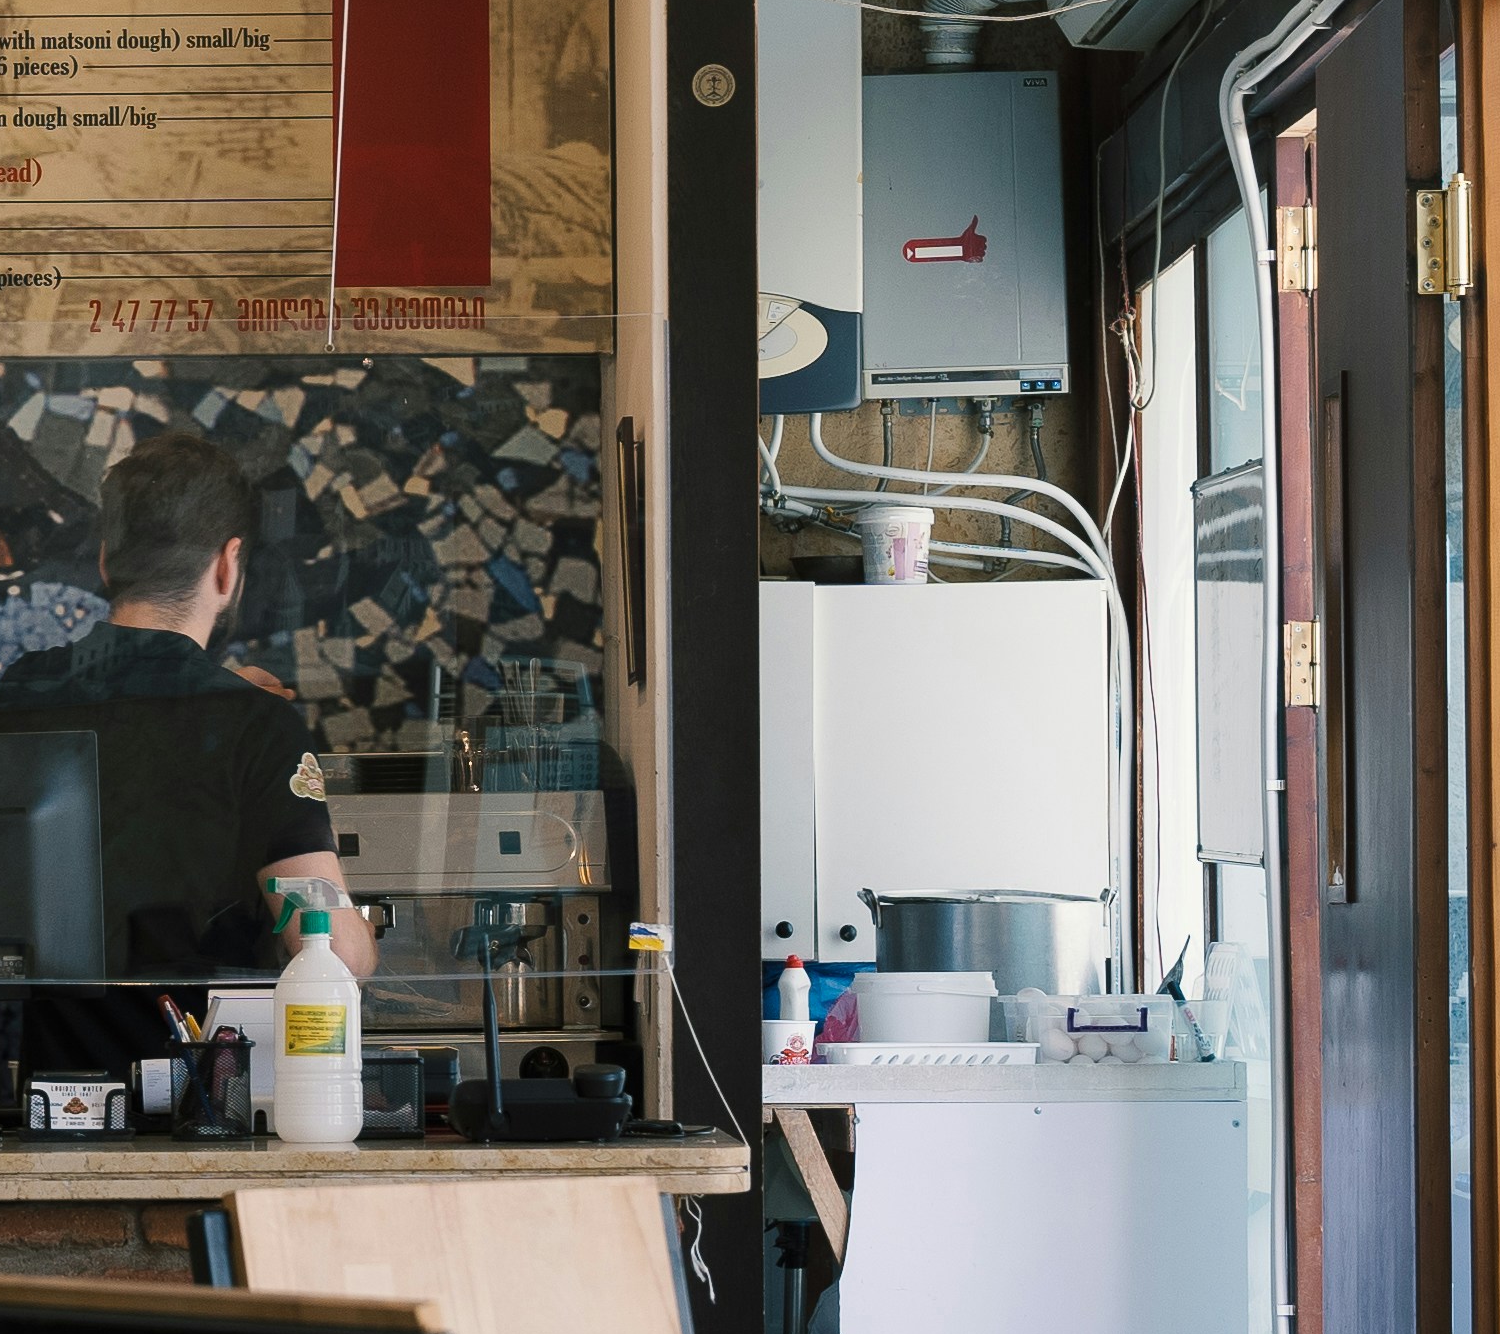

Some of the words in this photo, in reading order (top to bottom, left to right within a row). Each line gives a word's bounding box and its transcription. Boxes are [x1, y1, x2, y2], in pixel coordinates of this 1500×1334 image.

[41, 29, 111, 50] matsoni
[117, 28, 181, 52] dough)
[186, 27, 270, 51] small/big
[14, 55, 78, 79] pieces)
[12, 107, 67, 130] dough
[72, 106, 157, 130] small/big
[89, 300, 102, 333] 2
[111, 300, 140, 333] 47
[150, 300, 177, 333] 77
[187, 299, 214, 332] 57
